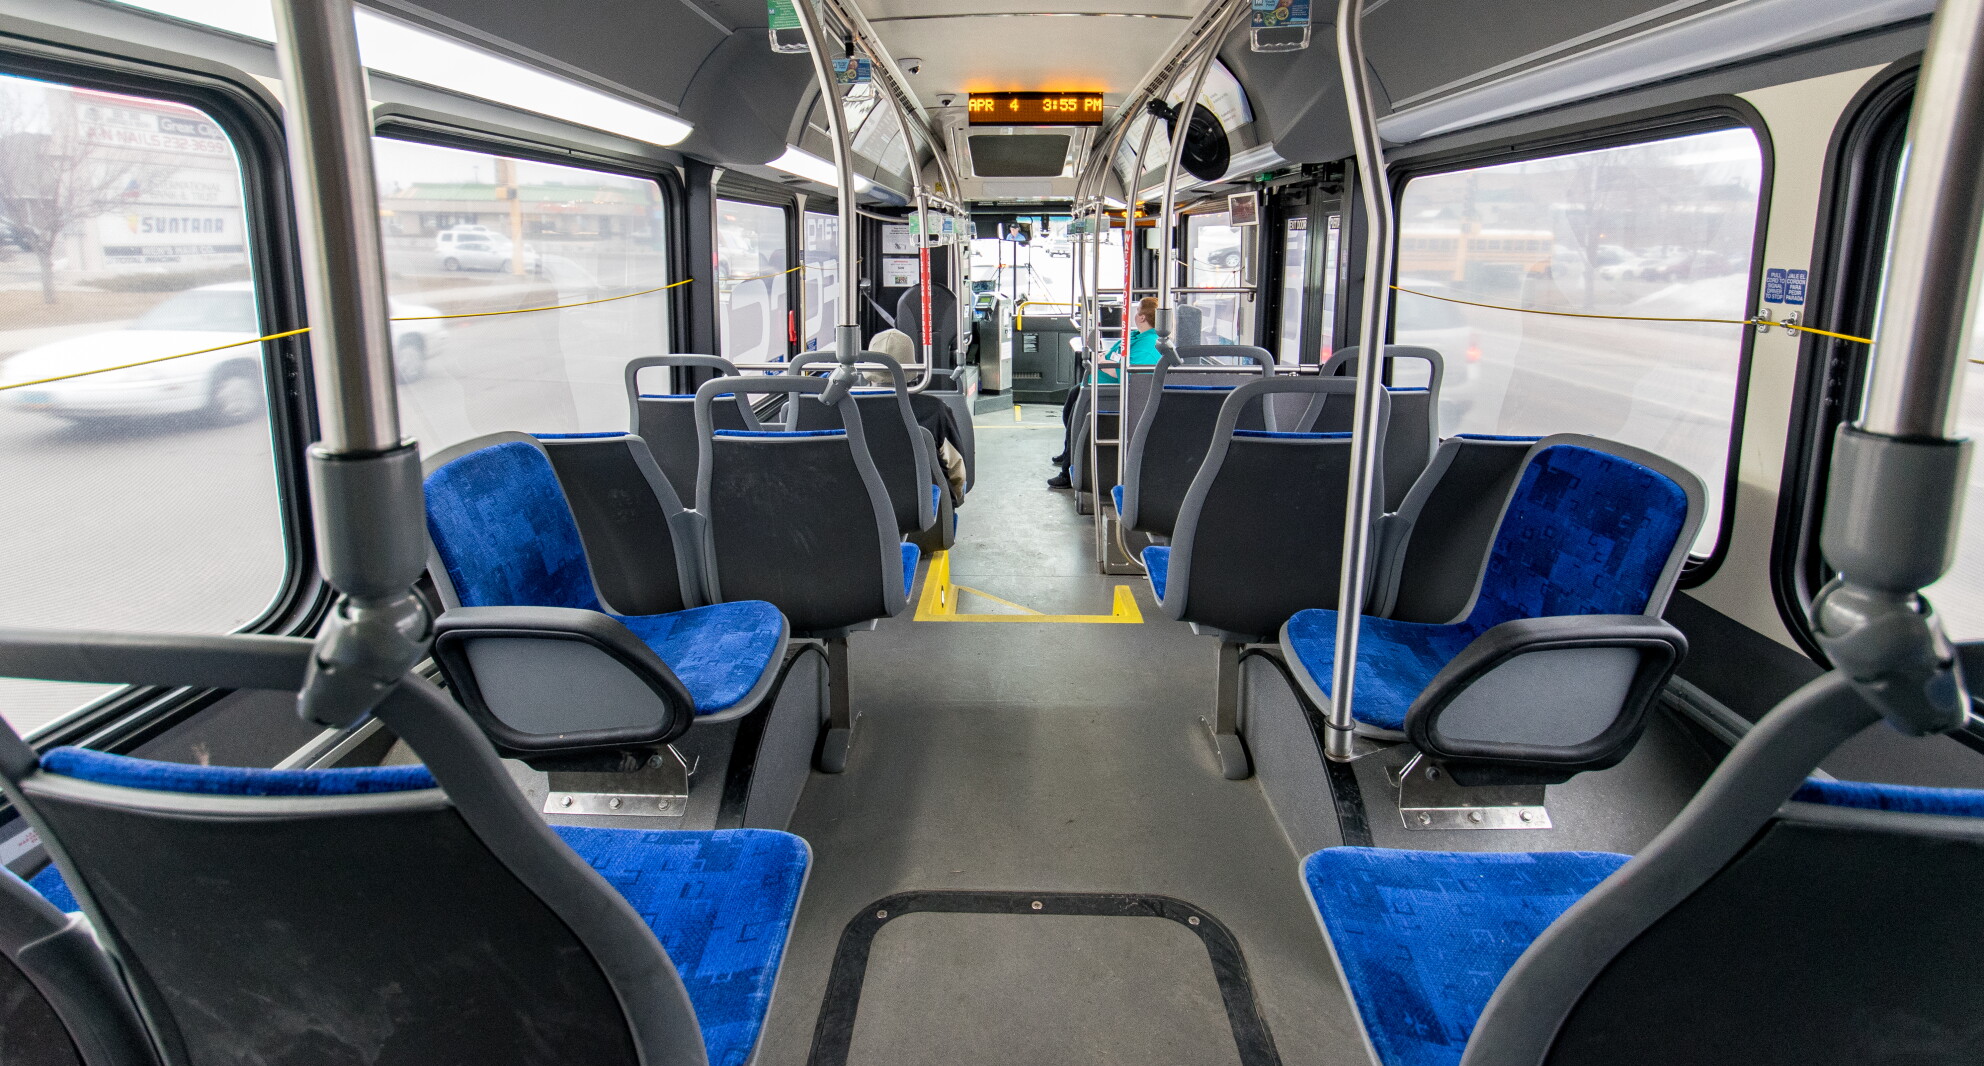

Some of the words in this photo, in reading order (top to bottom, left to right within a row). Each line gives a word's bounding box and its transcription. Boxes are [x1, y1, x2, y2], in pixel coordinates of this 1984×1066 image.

[969, 99, 994, 112] APR
[1009, 99, 1019, 112] 4
[1043, 99, 1077, 112] 3:55
[1084, 99, 1103, 112] PM
[117, 130, 161, 147] NAILS
[141, 216, 223, 233] SUNTANA
